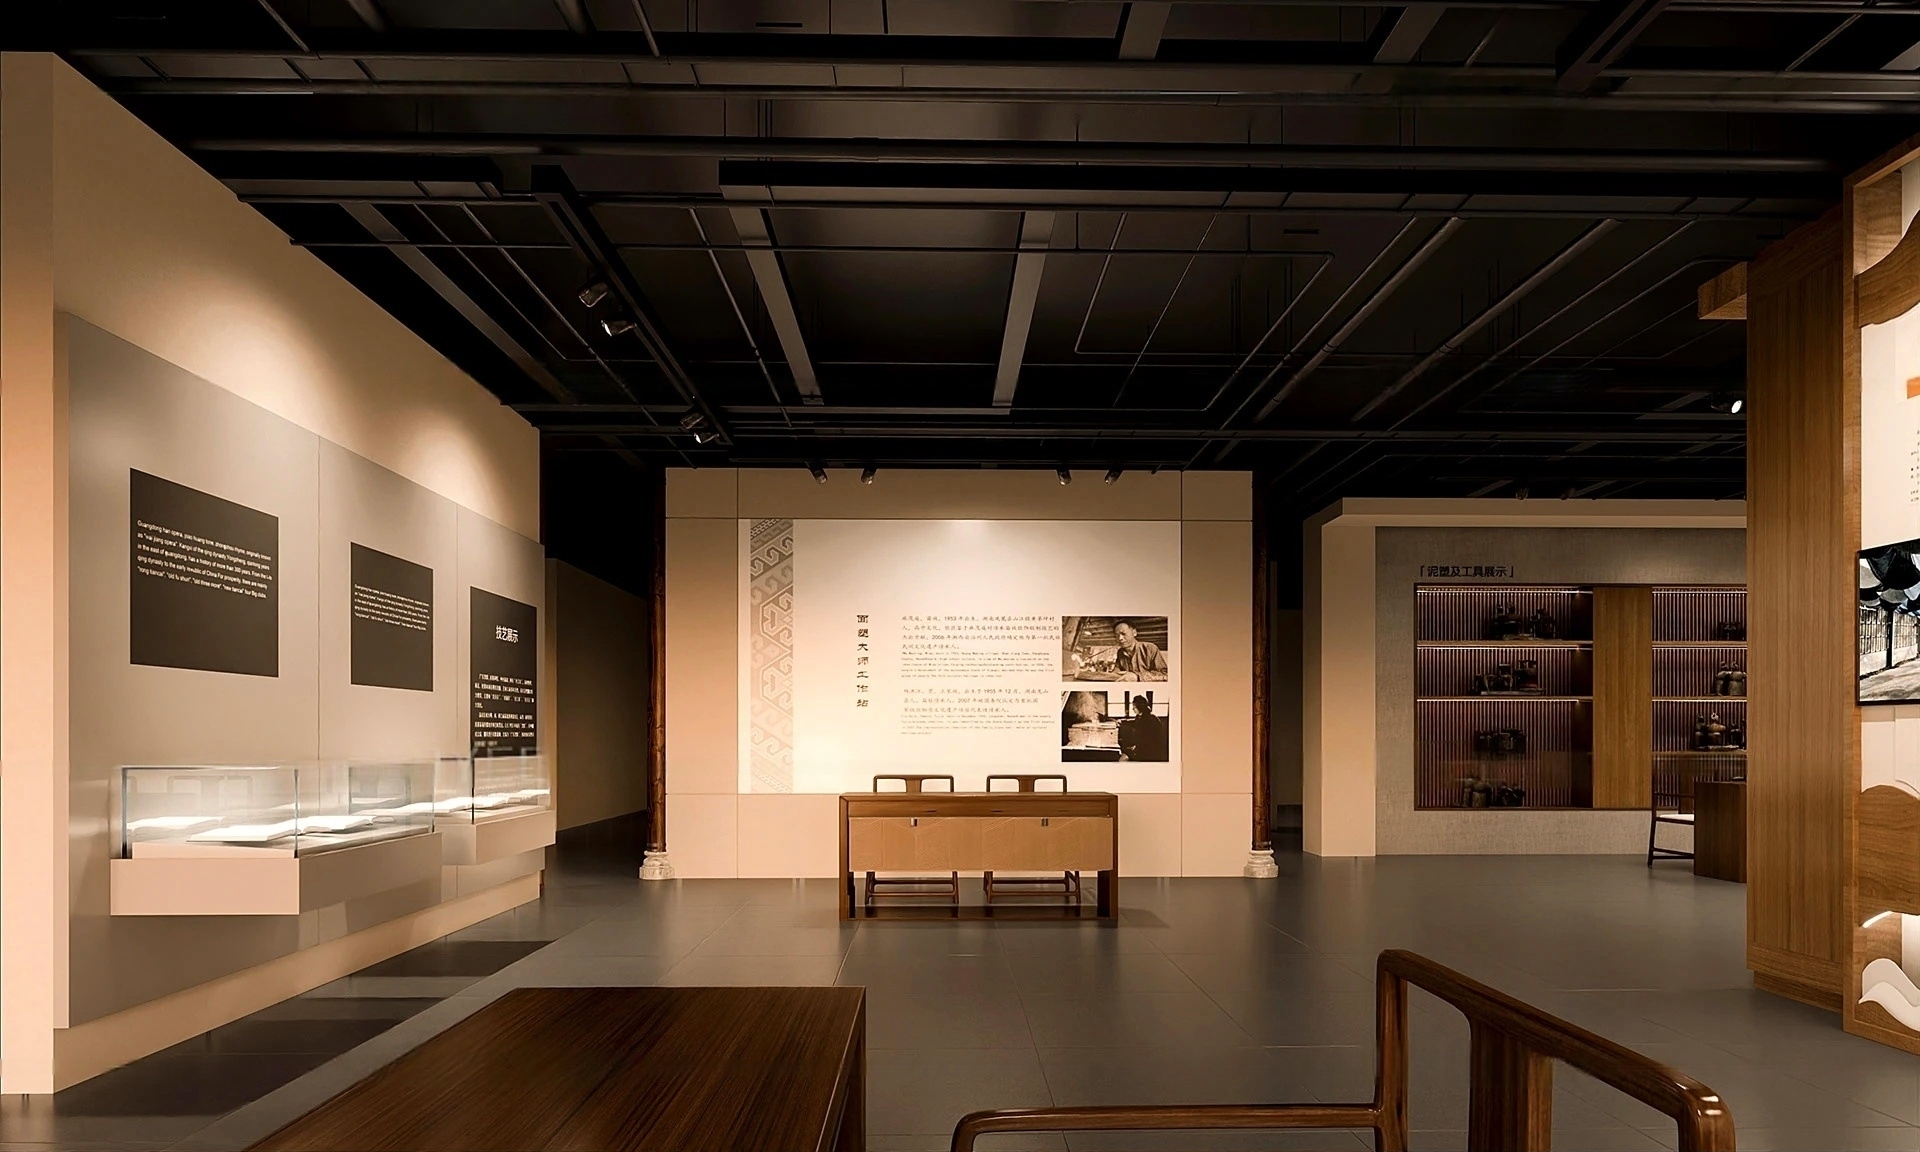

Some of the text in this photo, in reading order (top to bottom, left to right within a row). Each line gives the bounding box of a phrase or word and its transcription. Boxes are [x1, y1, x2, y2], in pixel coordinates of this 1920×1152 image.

[137, 520, 162, 533] Guangdong
[495, 625, 518, 643] 技艺展示
[856, 614, 869, 707] 面塑大师工作站
